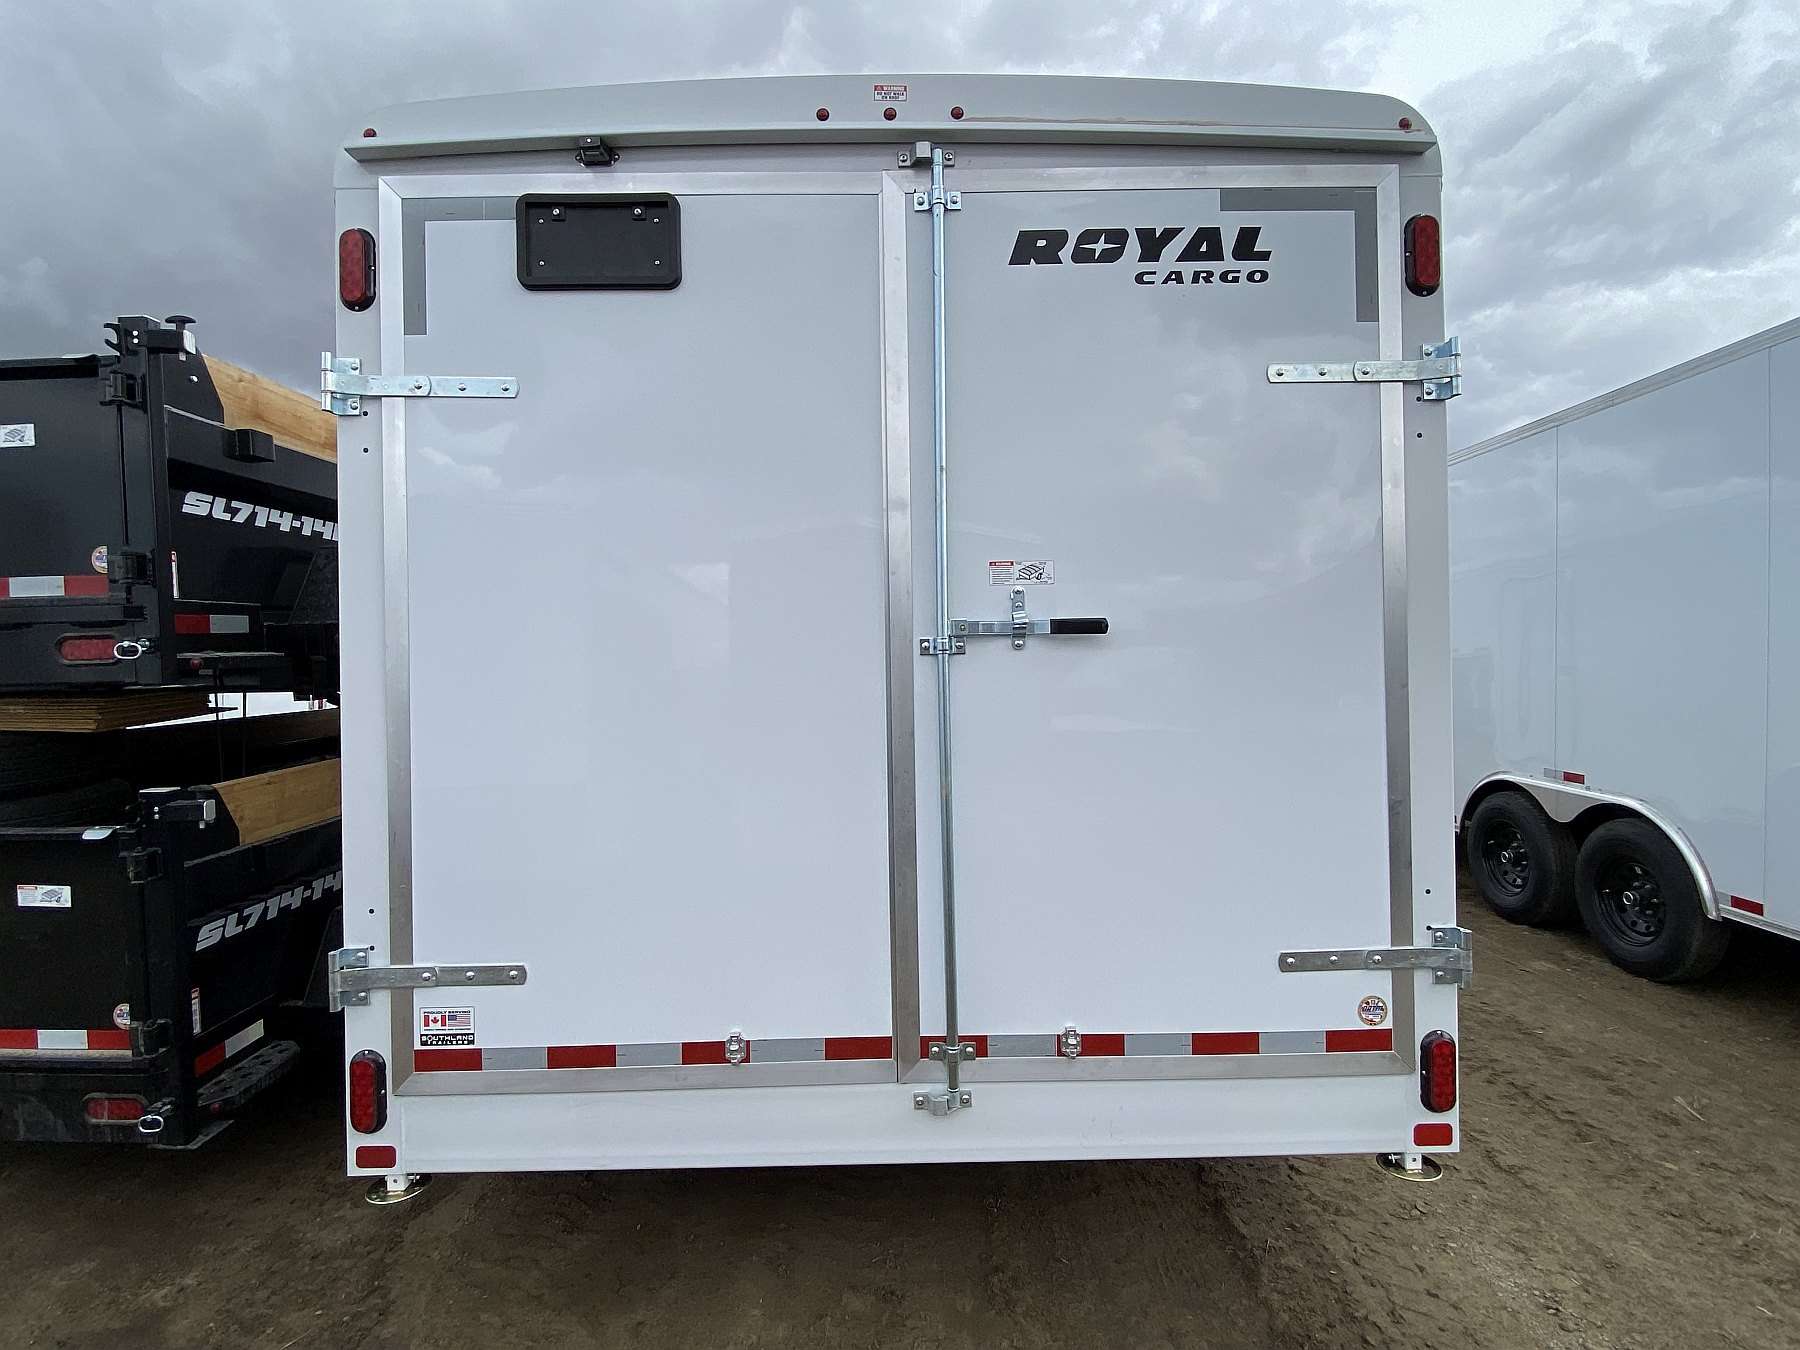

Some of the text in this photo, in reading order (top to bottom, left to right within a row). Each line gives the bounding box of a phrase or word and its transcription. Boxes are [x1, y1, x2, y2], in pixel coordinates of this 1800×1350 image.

[1008, 227, 1272, 265] ROYAL
[1135, 270, 1270, 285] CARGO
[182, 491, 338, 541] SL714-14
